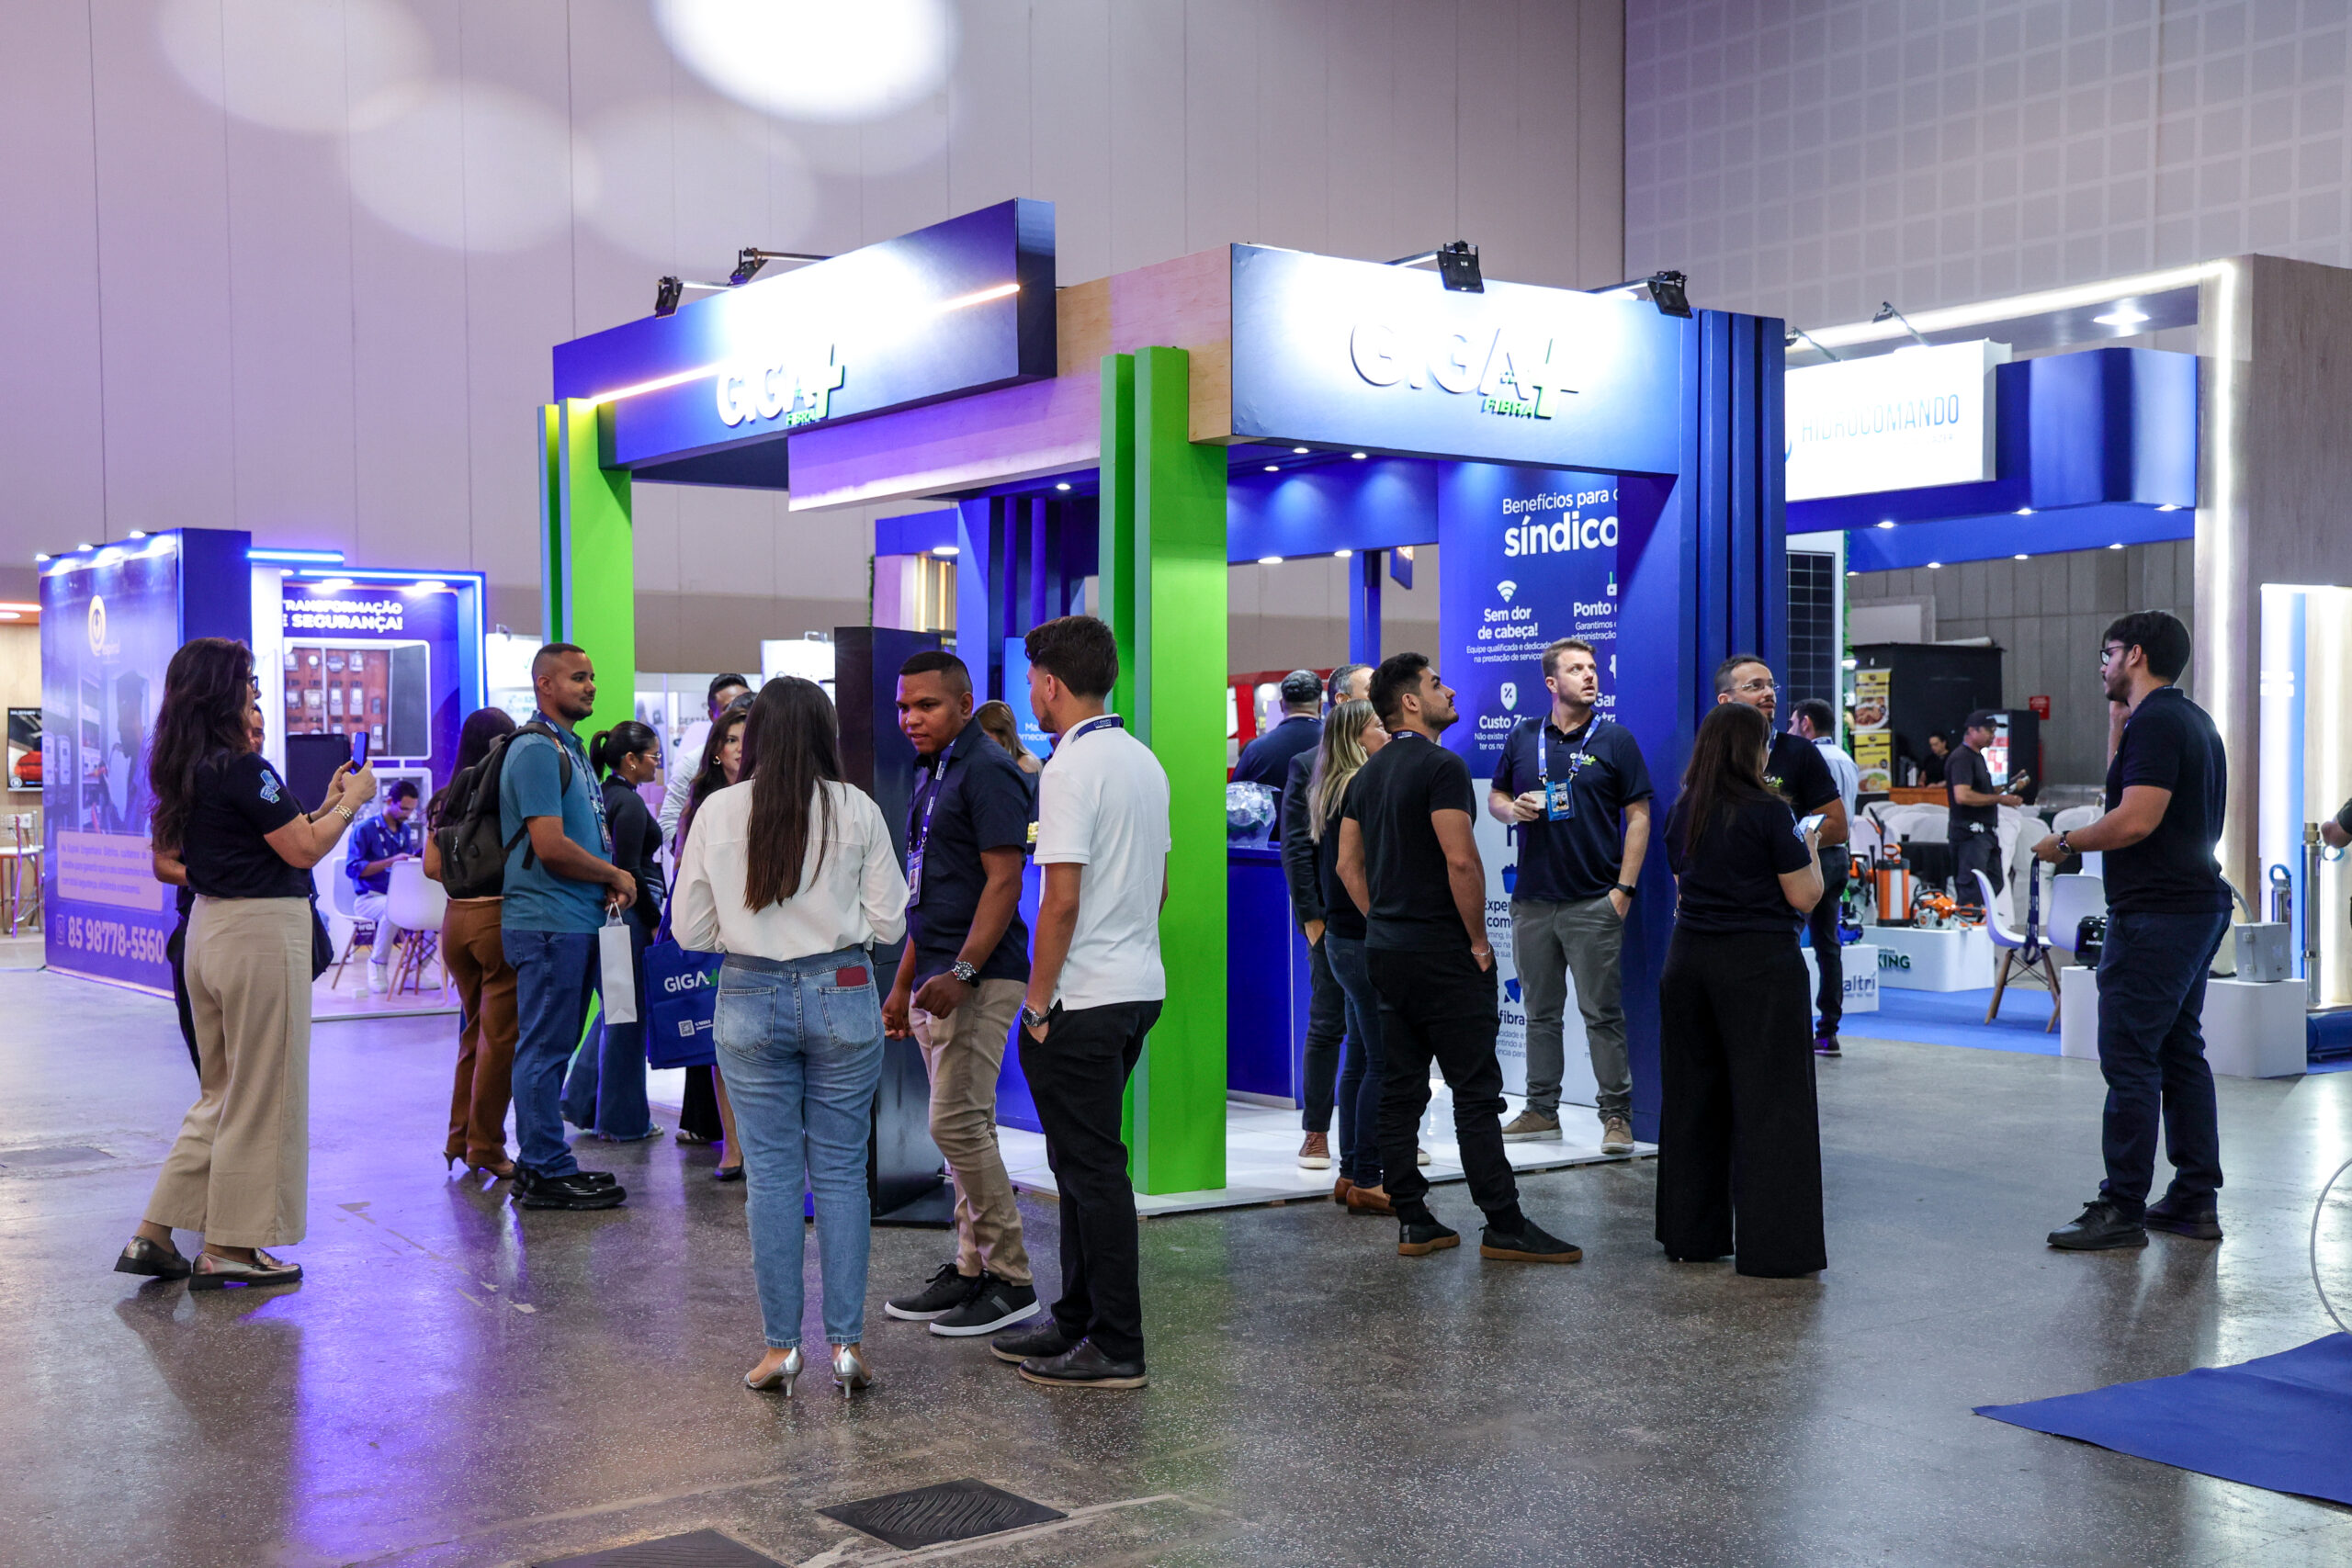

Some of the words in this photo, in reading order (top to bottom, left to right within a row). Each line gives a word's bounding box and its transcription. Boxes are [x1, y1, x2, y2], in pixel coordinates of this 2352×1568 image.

[1482, 396, 1533, 419] FIBRA
[1502, 492, 1573, 514] Benefícios
[1577, 490, 1609, 509] para
[1504, 510, 1618, 558] síndico
[1484, 607, 1510, 623] Sem
[1510, 605, 1532, 620] dor
[1573, 601, 1611, 617] Ponto
[291, 614, 403, 634] SEGURANÇA!
[1477, 625, 1493, 640] de
[1494, 622, 1538, 640] cabeça!
[1575, 621, 1613, 631] Garantimos
[1466, 645, 1486, 655] Equipe
[1487, 642, 1518, 653] qualificada
[1482, 654, 1510, 664] prestação
[1510, 653, 1519, 661] de
[1479, 715, 1511, 729] Custo
[1474, 731, 1487, 740] Não
[1487, 732, 1504, 740] existe
[1479, 742, 1487, 750] ter
[68, 916, 83, 949] 85
[85, 918, 164, 964] 98778-5560
[1498, 1009, 1525, 1025] fibra
